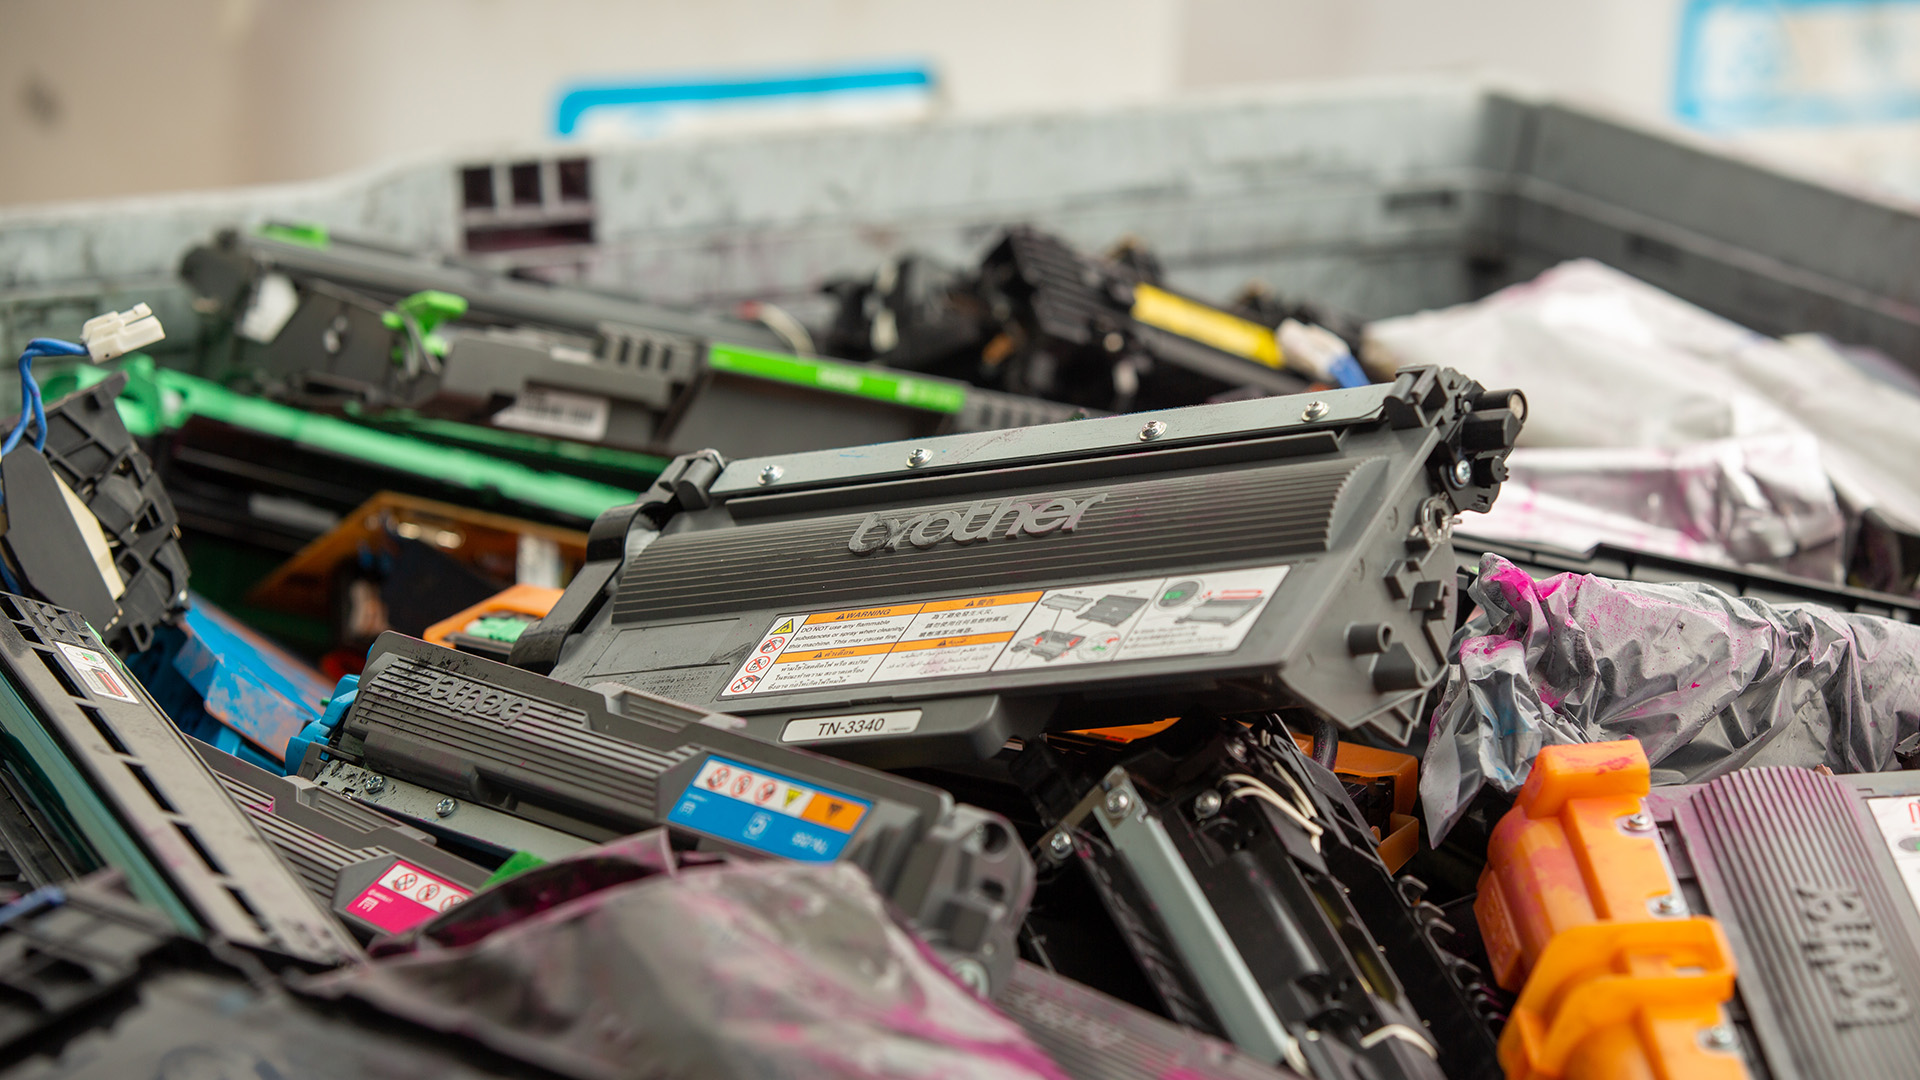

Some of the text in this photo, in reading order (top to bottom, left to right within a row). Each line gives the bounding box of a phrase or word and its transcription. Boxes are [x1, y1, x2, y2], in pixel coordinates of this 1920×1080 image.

[849, 493, 1108, 556] brother
[846, 609, 891, 619] WARNING
[794, 632, 831, 641] substances
[840, 630, 858, 638] spray
[858, 627, 877, 635] when
[877, 625, 904, 634] cleaning
[802, 640, 831, 648] machine.
[417, 673, 530, 729] brother
[818, 718, 885, 737] TN-3340
